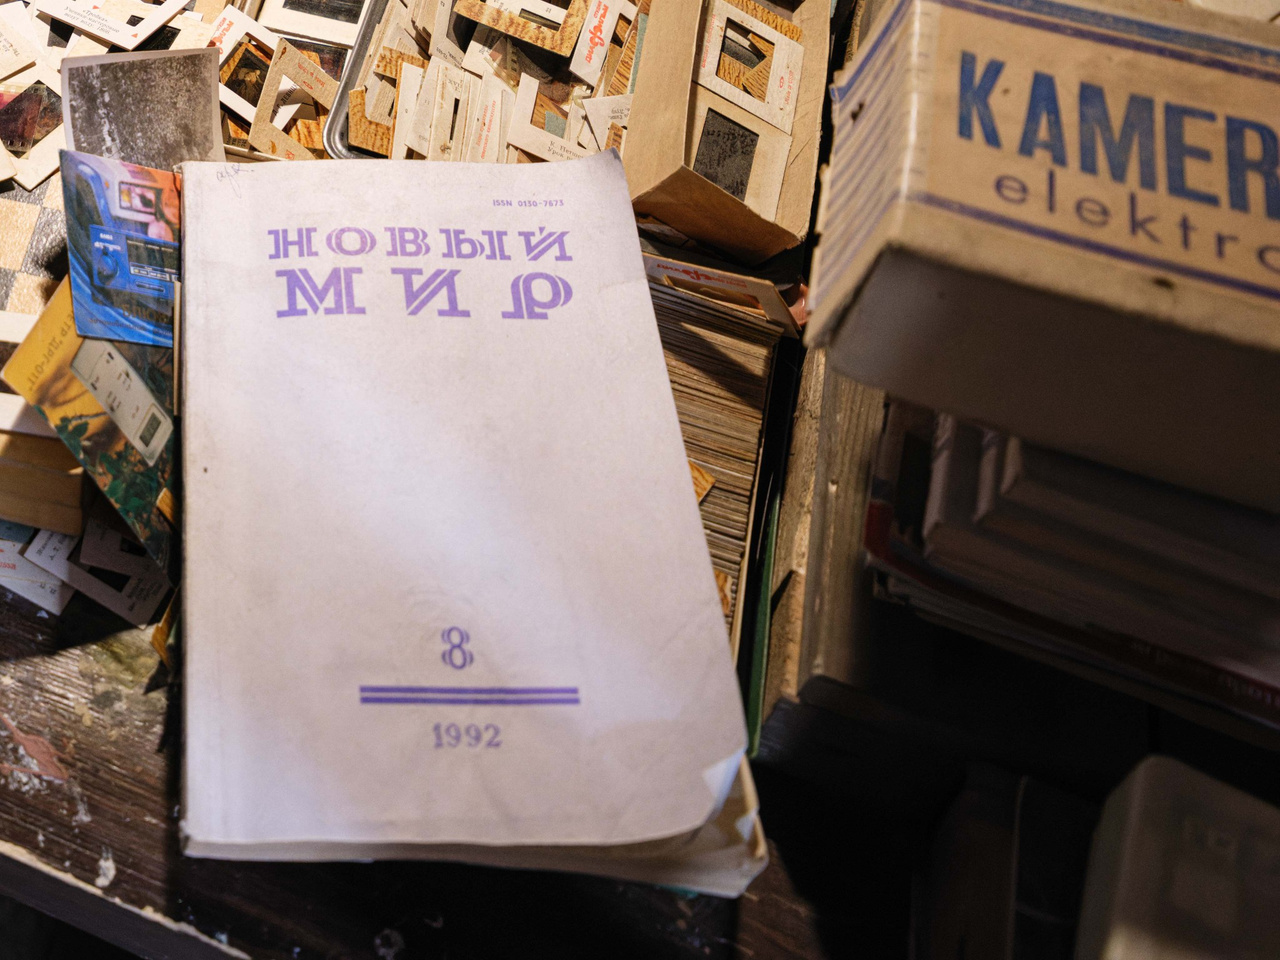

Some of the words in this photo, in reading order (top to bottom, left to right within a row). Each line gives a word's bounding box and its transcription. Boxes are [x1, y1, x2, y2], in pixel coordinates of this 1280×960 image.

[546, 146, 565, 157] Урок
[492, 197, 513, 208] ISSN
[268, 227, 573, 261] НОВЫЙ
[276, 266, 574, 320] МИР
[440, 626, 475, 670] 8
[431, 722, 502, 749] 1992
